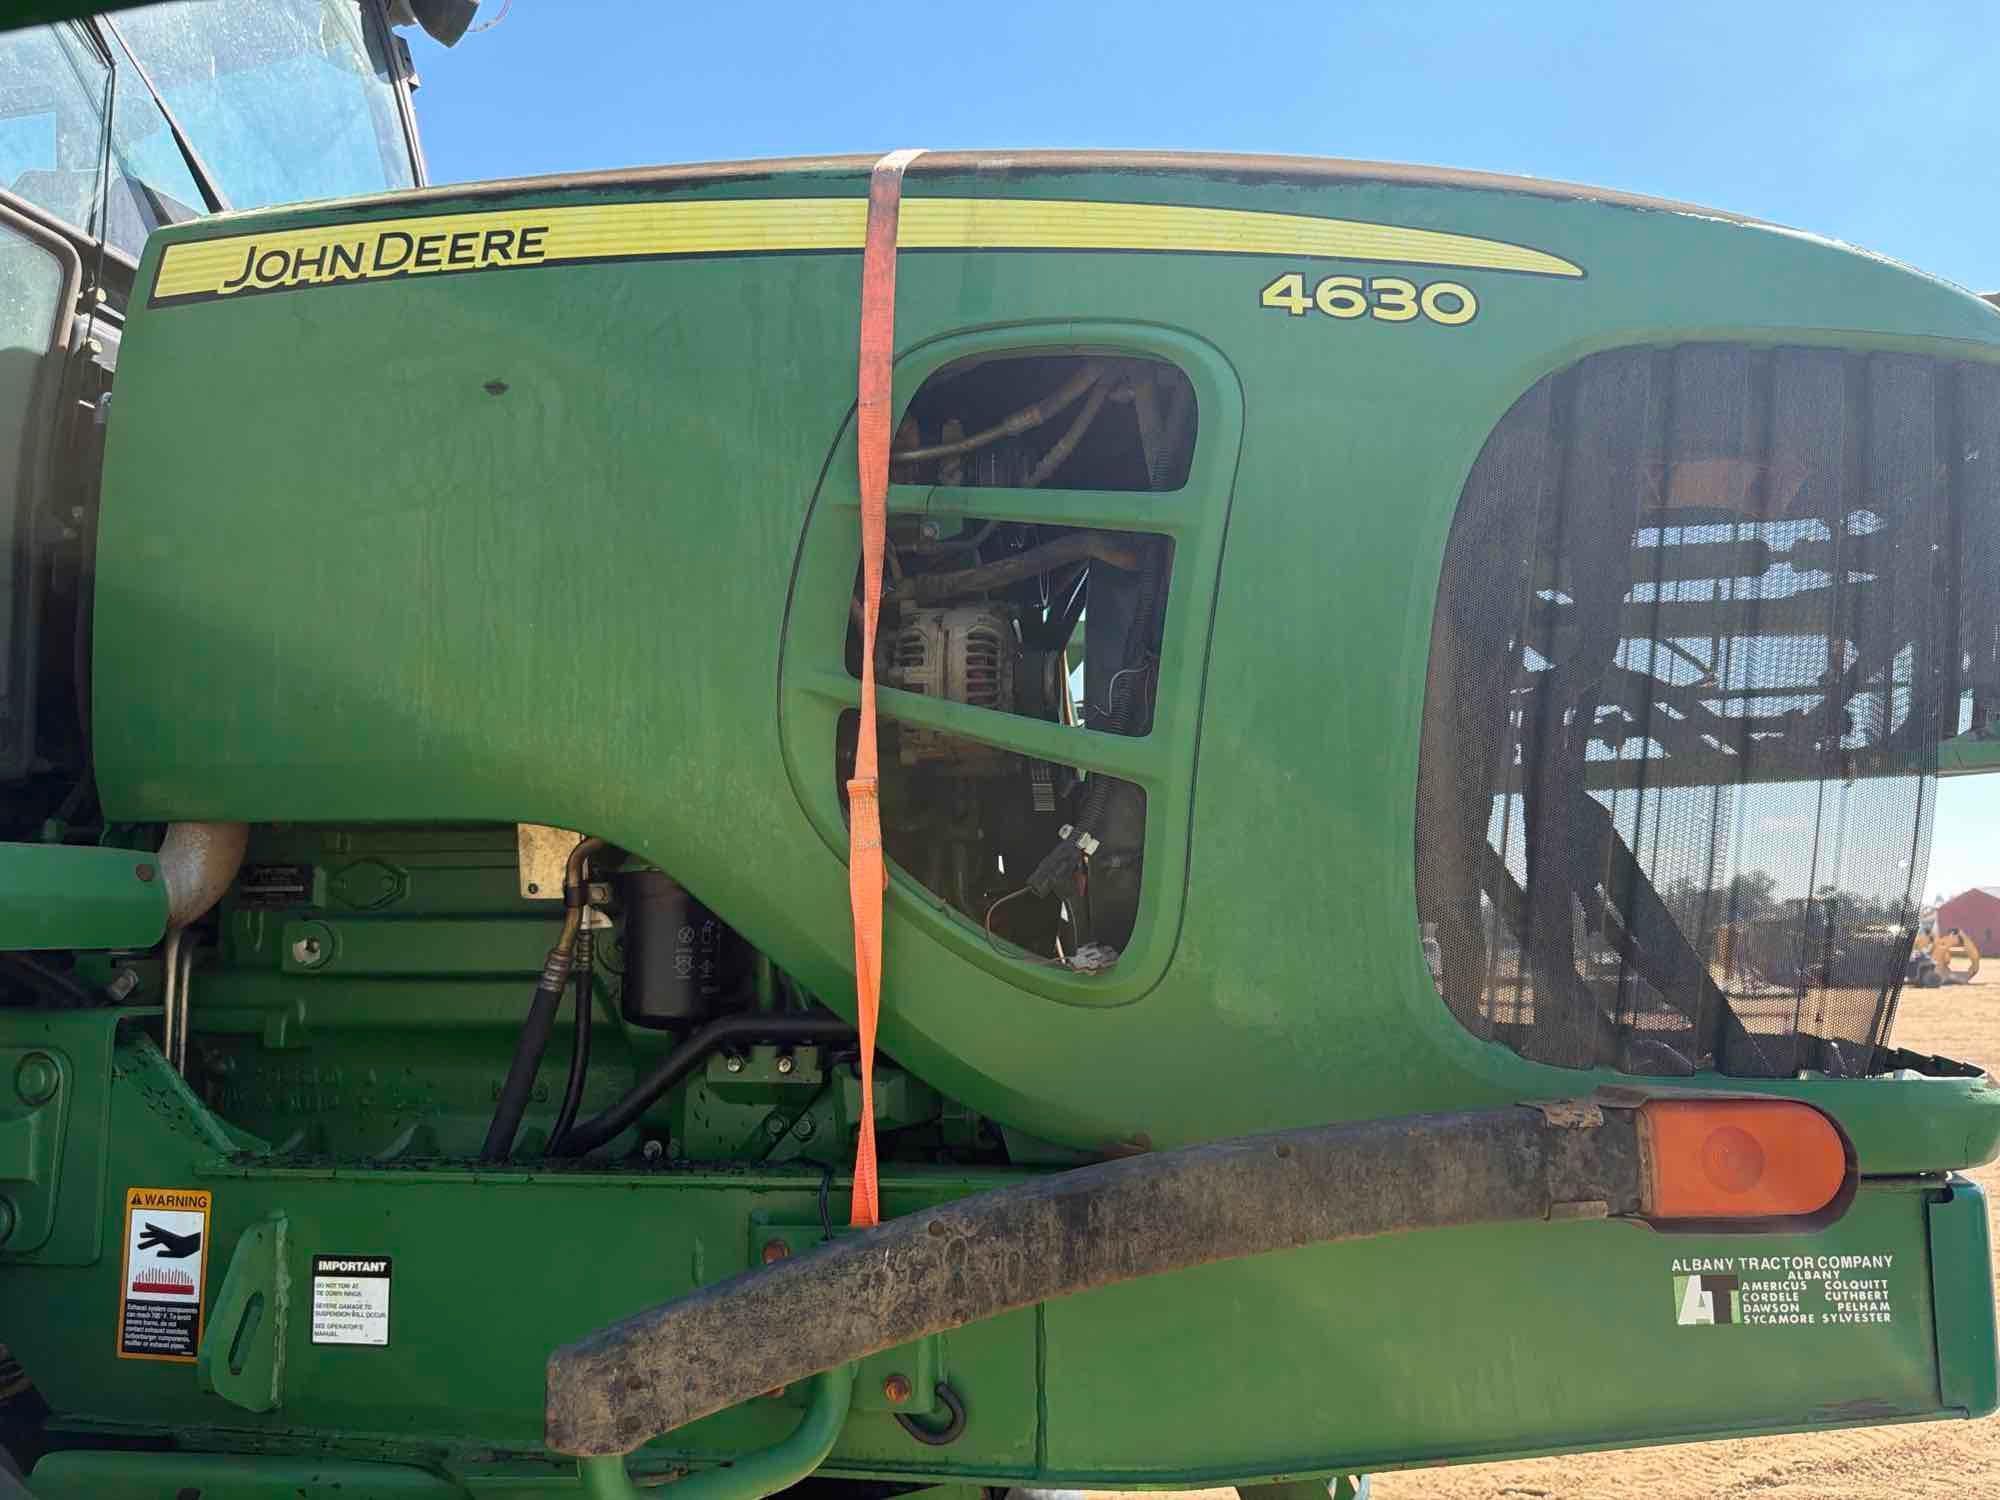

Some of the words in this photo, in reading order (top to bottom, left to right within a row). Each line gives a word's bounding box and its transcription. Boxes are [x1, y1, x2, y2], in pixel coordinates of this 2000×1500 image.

[223, 241, 365, 288] JOHN
[373, 226, 549, 272] DEERE
[1260, 272, 1479, 326] 4630
[145, 1194, 208, 1208] WARNING
[318, 1260, 387, 1272] IMPORTANT
[1672, 1258, 1733, 1271] ALBANY
[1738, 1256, 1814, 1270] TRACTOR
[1818, 1255, 1893, 1269] COMPANY
[1788, 1270, 1840, 1280] ALBANY
[1742, 1281, 1807, 1291] AMERICUS
[1824, 1280, 1888, 1290] COLQUITT
[1742, 1292, 1799, 1302] CORDELE
[1825, 1291, 1889, 1301] CUTHBERT
[1743, 1303, 1800, 1313] DAWSON
[1837, 1302, 1890, 1312] PELHAM
[1743, 1314, 1815, 1324] SYCAMORE
[1822, 1313, 1891, 1323] SYLVESTER
